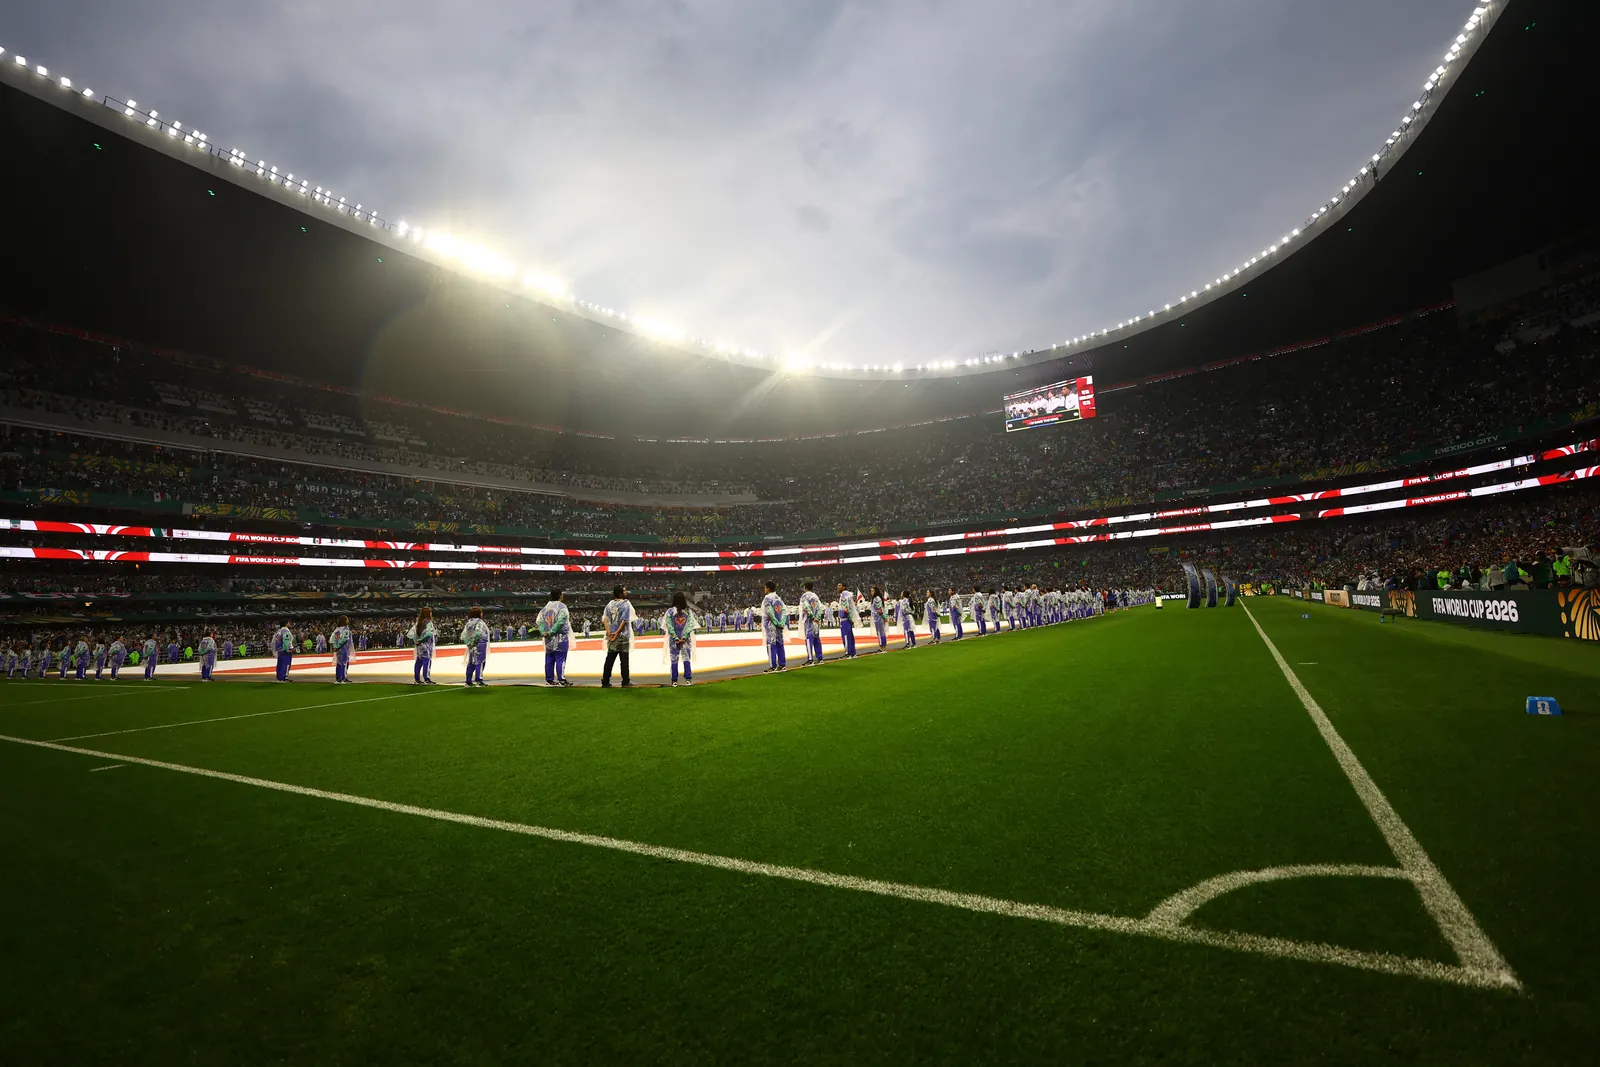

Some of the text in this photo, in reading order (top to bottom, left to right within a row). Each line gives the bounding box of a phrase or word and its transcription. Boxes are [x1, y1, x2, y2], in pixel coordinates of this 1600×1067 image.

[1476, 435, 1498, 444] CITY
[1432, 598, 1519, 622] FIFA WORLD CUP 2026
